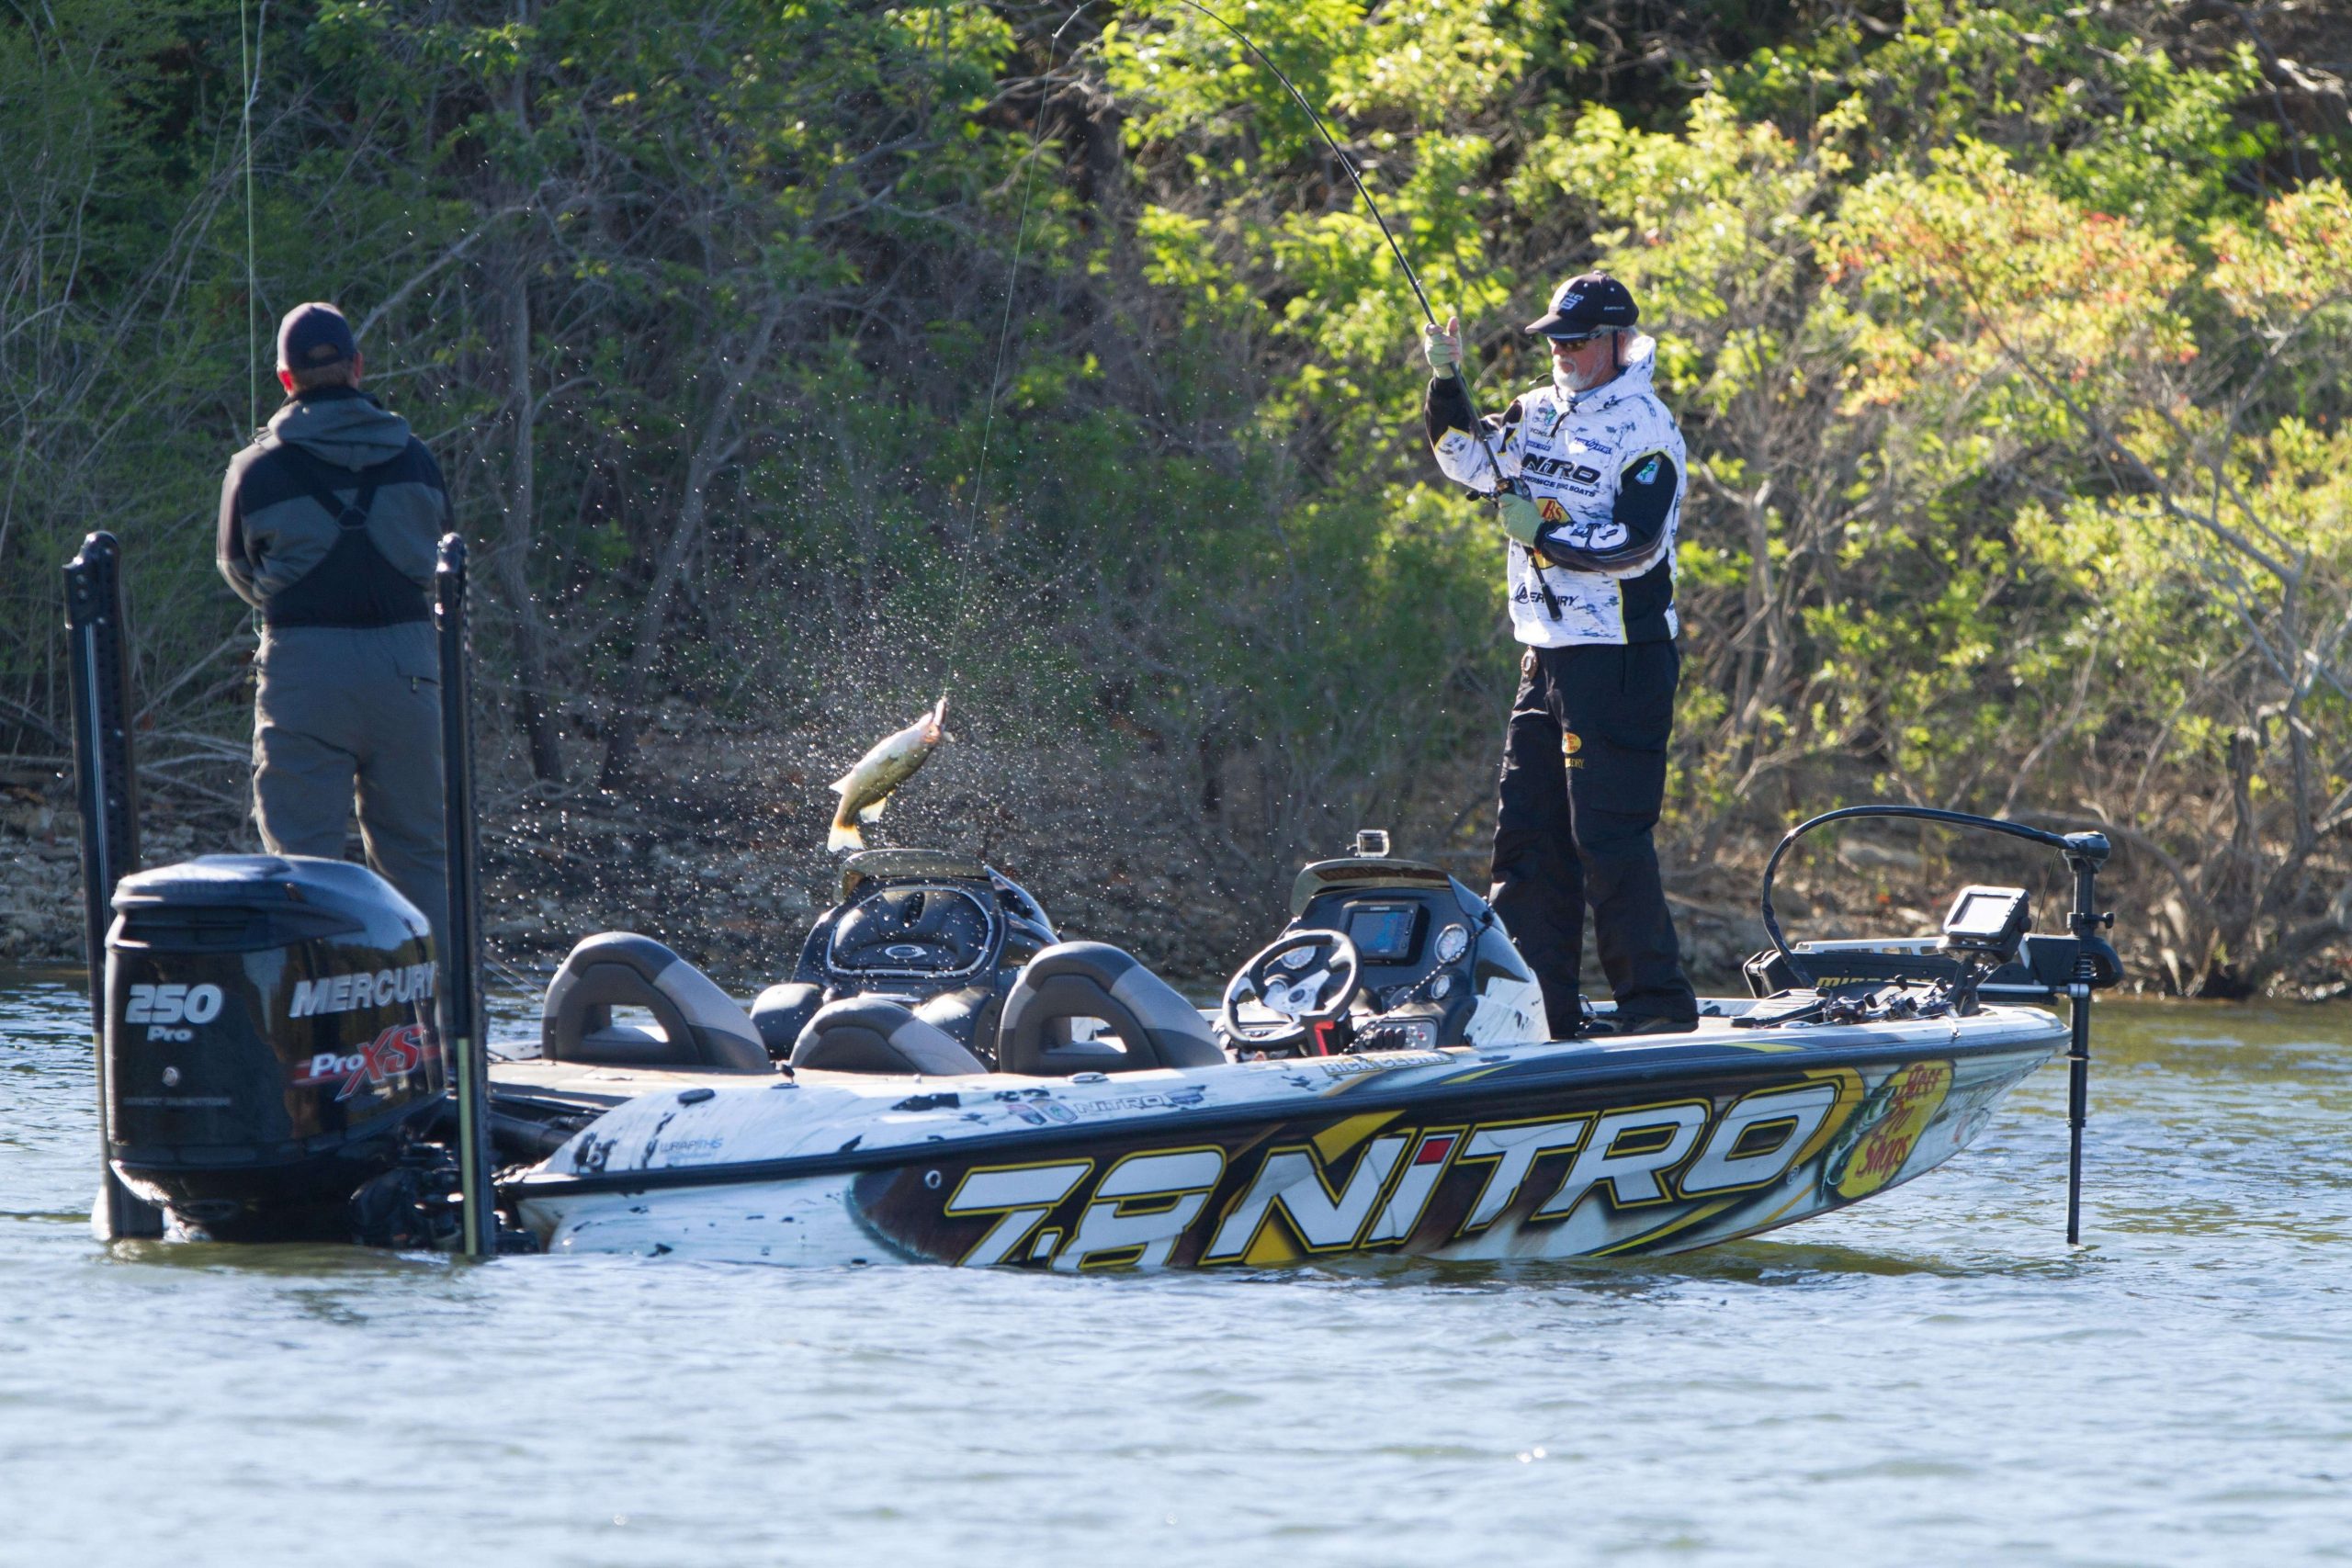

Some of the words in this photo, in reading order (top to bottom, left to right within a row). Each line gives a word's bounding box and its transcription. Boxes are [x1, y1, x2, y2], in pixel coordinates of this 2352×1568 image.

[1521, 452, 1601, 486] NITRO
[124, 984, 223, 1024] 250
[288, 961, 438, 1018] MERCURY
[147, 1025, 193, 1042] Pro
[1073, 1093, 1168, 1115] NITRO
[1197, 1077, 1846, 1266] NITRO
[1855, 1132, 1913, 1179] Shops
